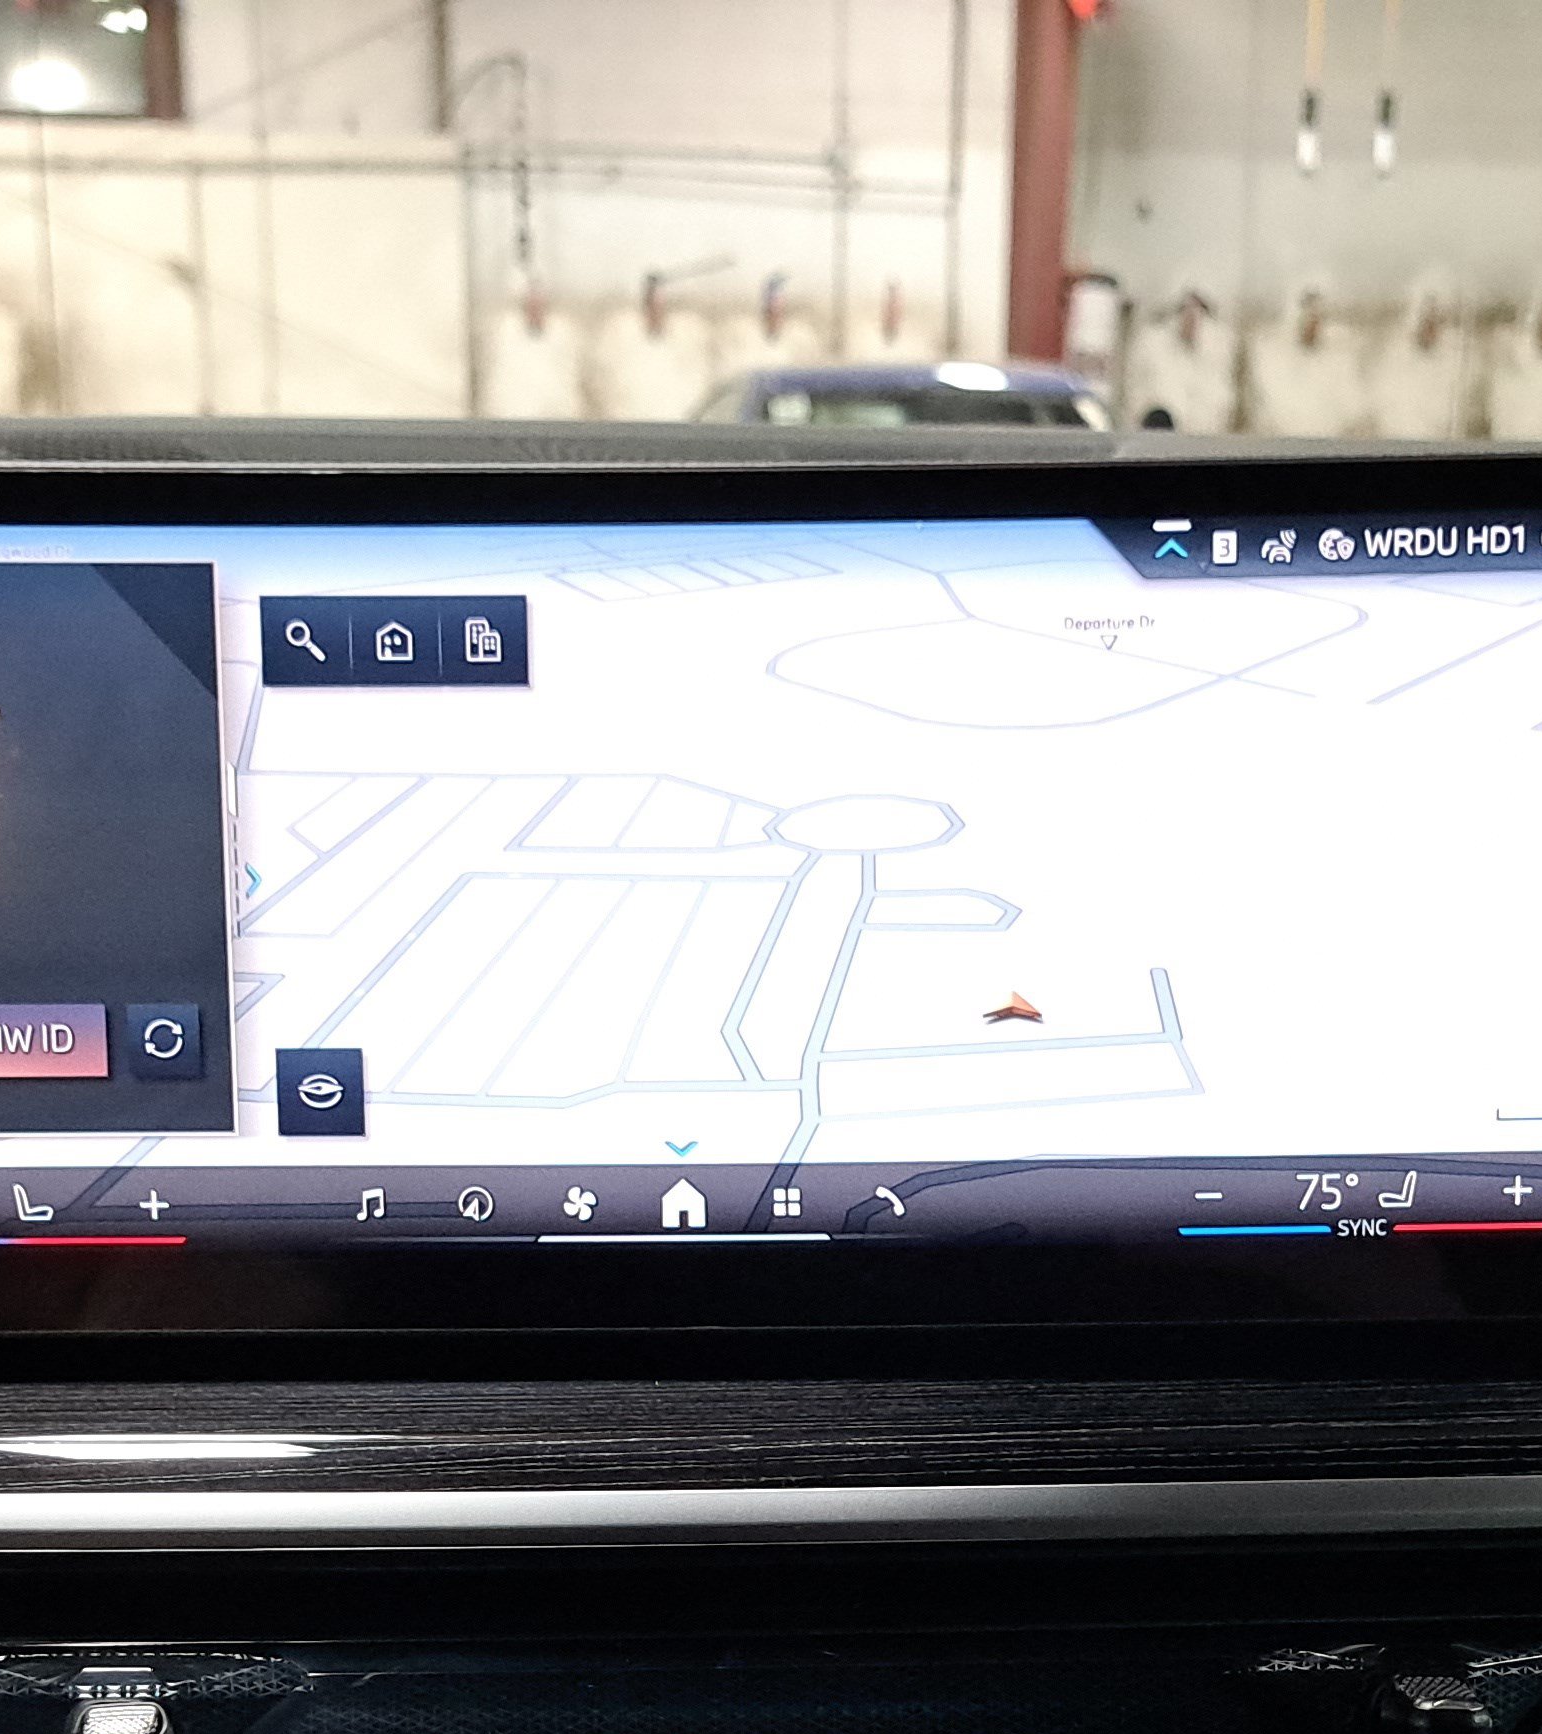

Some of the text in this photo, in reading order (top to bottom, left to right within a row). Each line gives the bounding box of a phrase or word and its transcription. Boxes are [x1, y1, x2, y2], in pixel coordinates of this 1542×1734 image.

[1364, 525, 1526, 557] WRDU HD1
[1064, 615, 1155, 631] Departure Dr
[42, 1023, 75, 1054] ID
[1295, 1173, 1359, 1211] 75°
[1336, 1219, 1388, 1238] SYNC
